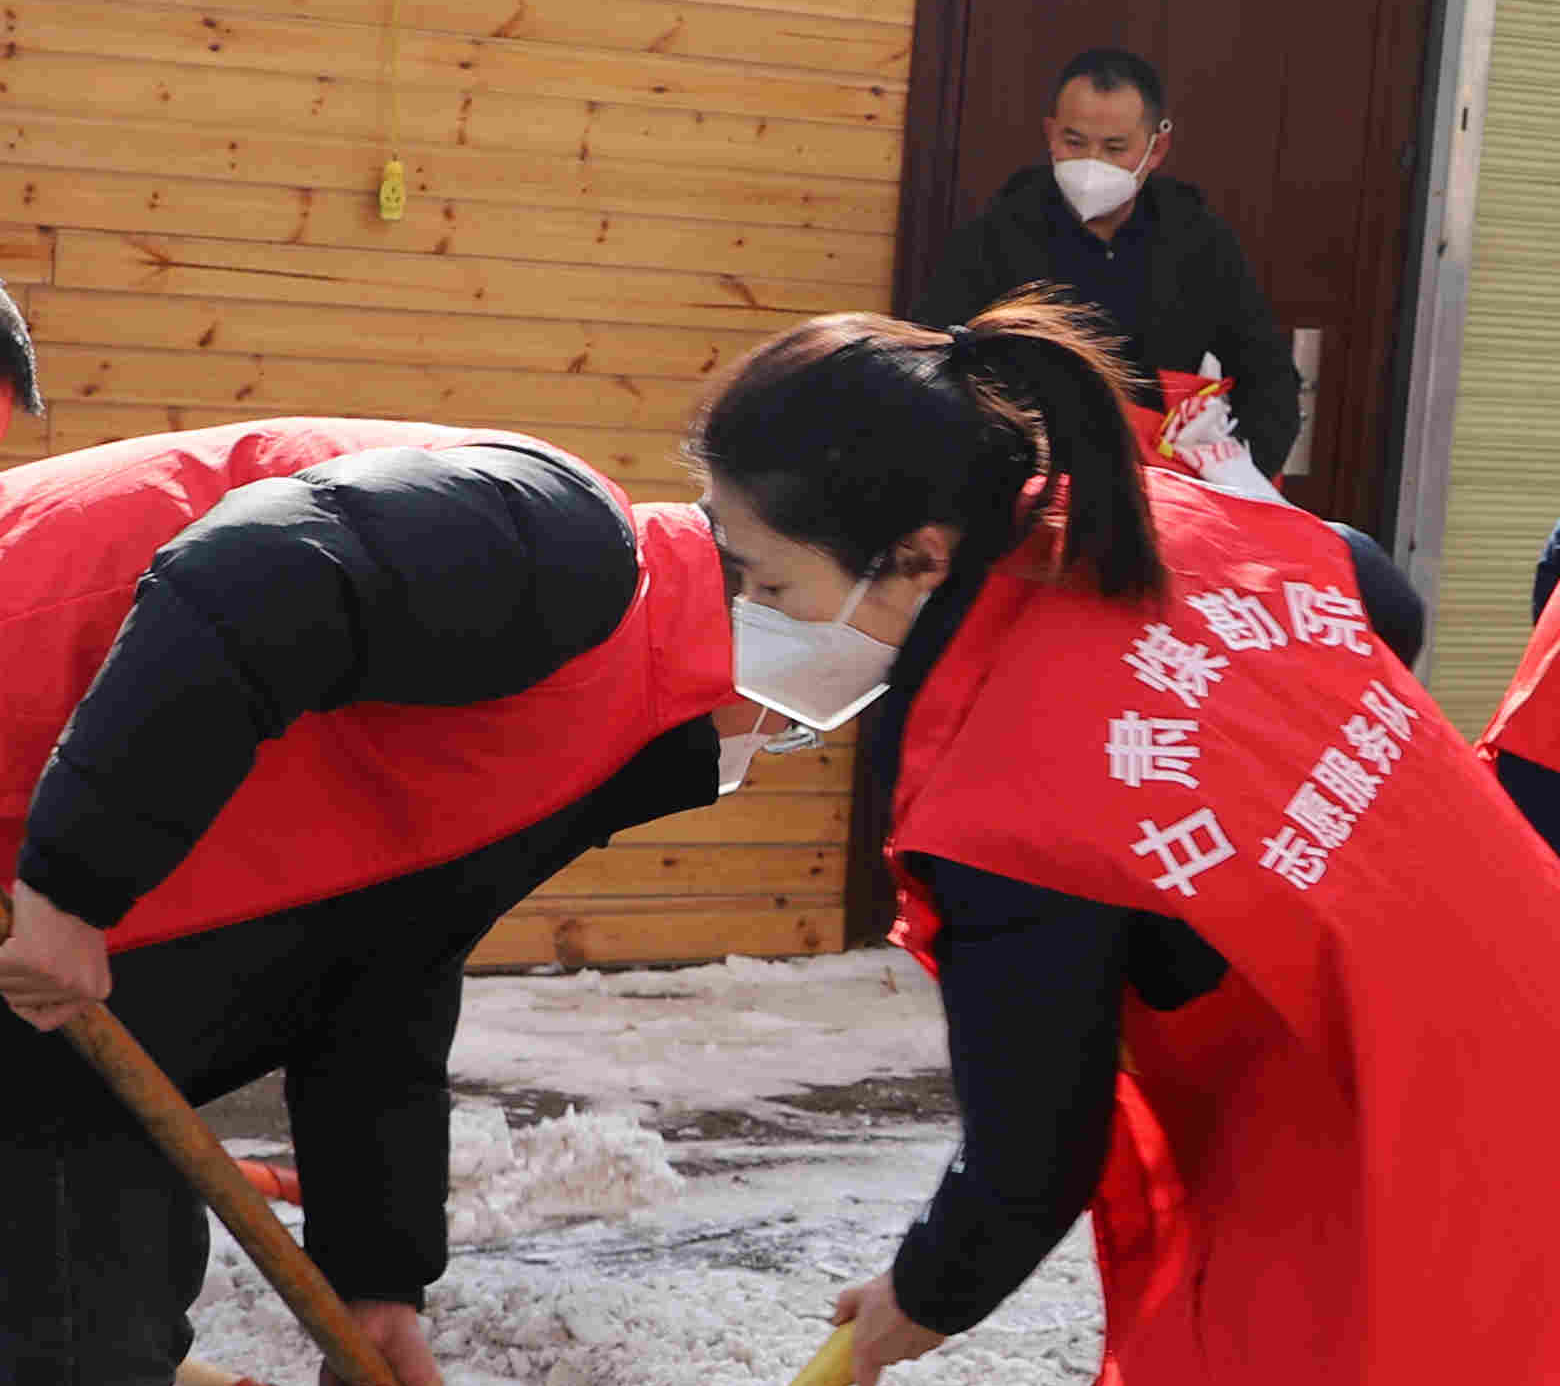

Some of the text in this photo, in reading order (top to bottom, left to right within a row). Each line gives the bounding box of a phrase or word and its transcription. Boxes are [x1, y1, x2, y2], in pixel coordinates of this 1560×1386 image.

[1258, 679, 1420, 891] 志愿服务队
